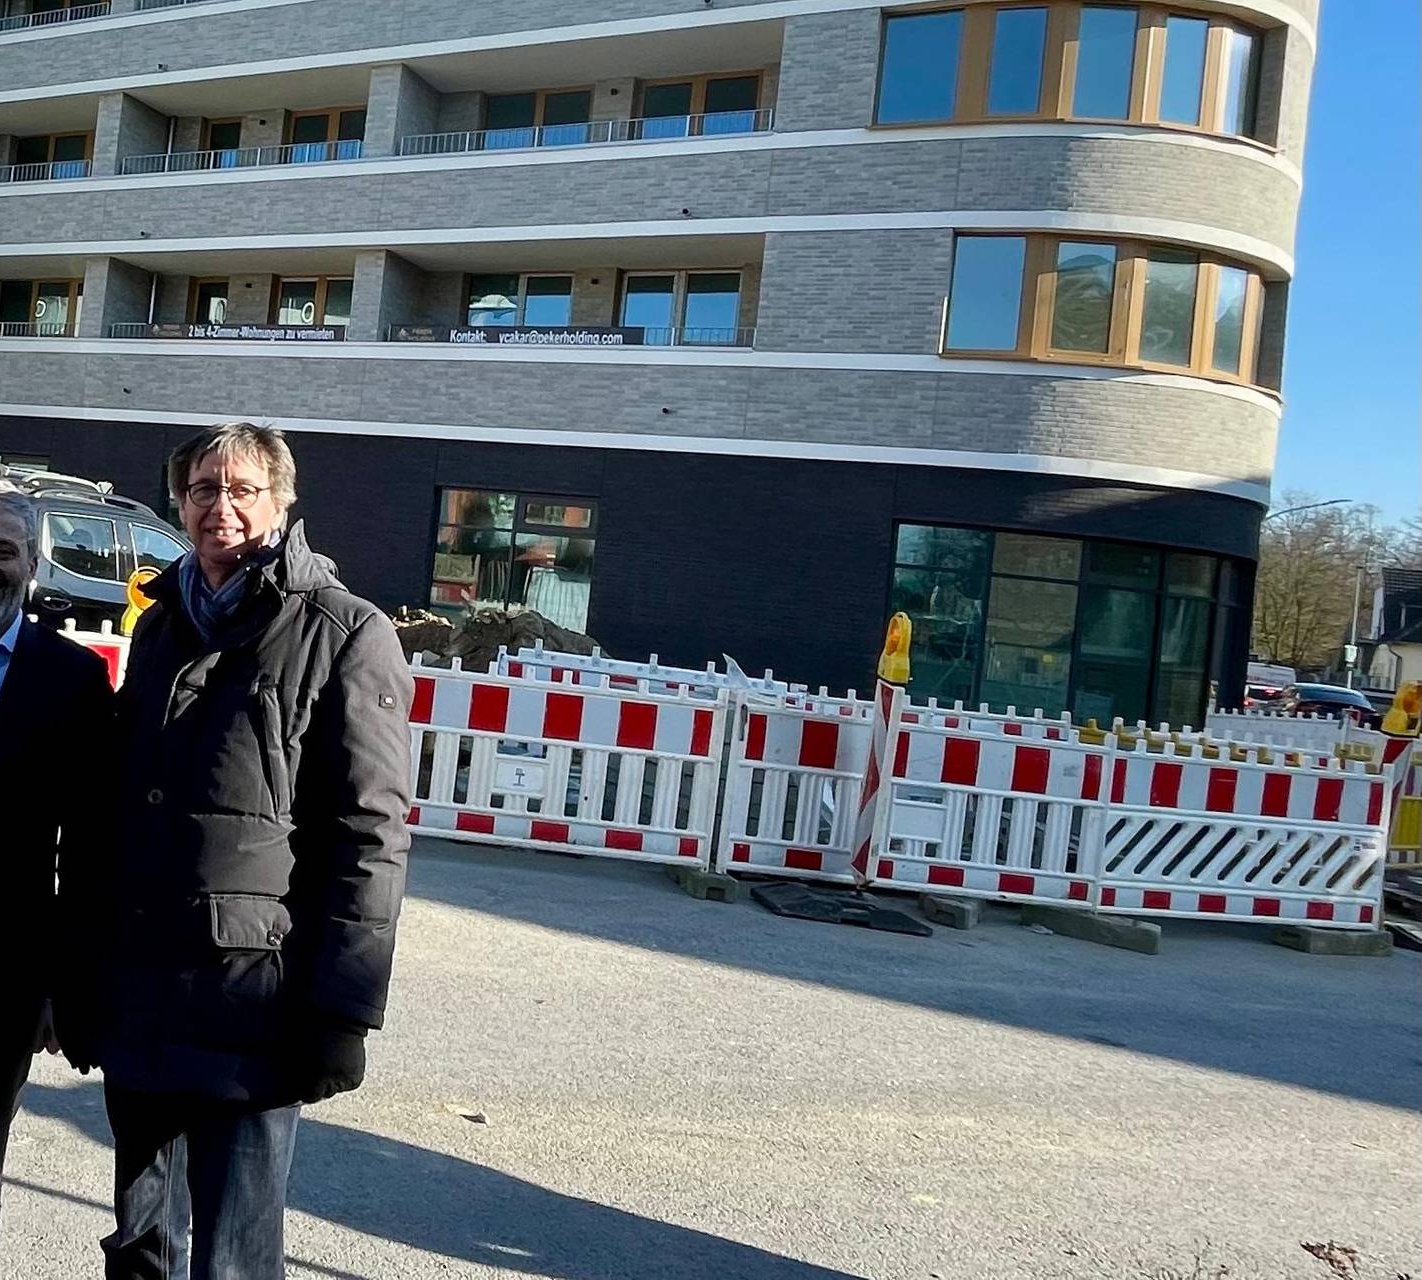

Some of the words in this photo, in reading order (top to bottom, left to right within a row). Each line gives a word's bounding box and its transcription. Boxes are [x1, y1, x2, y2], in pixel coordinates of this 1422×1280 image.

[188, 324, 194, 338] 2
[194, 324, 206, 338] bis
[286, 329, 296, 339] zu
[297, 327, 335, 340] vermieten
[449, 329, 487, 343] Kontakt:
